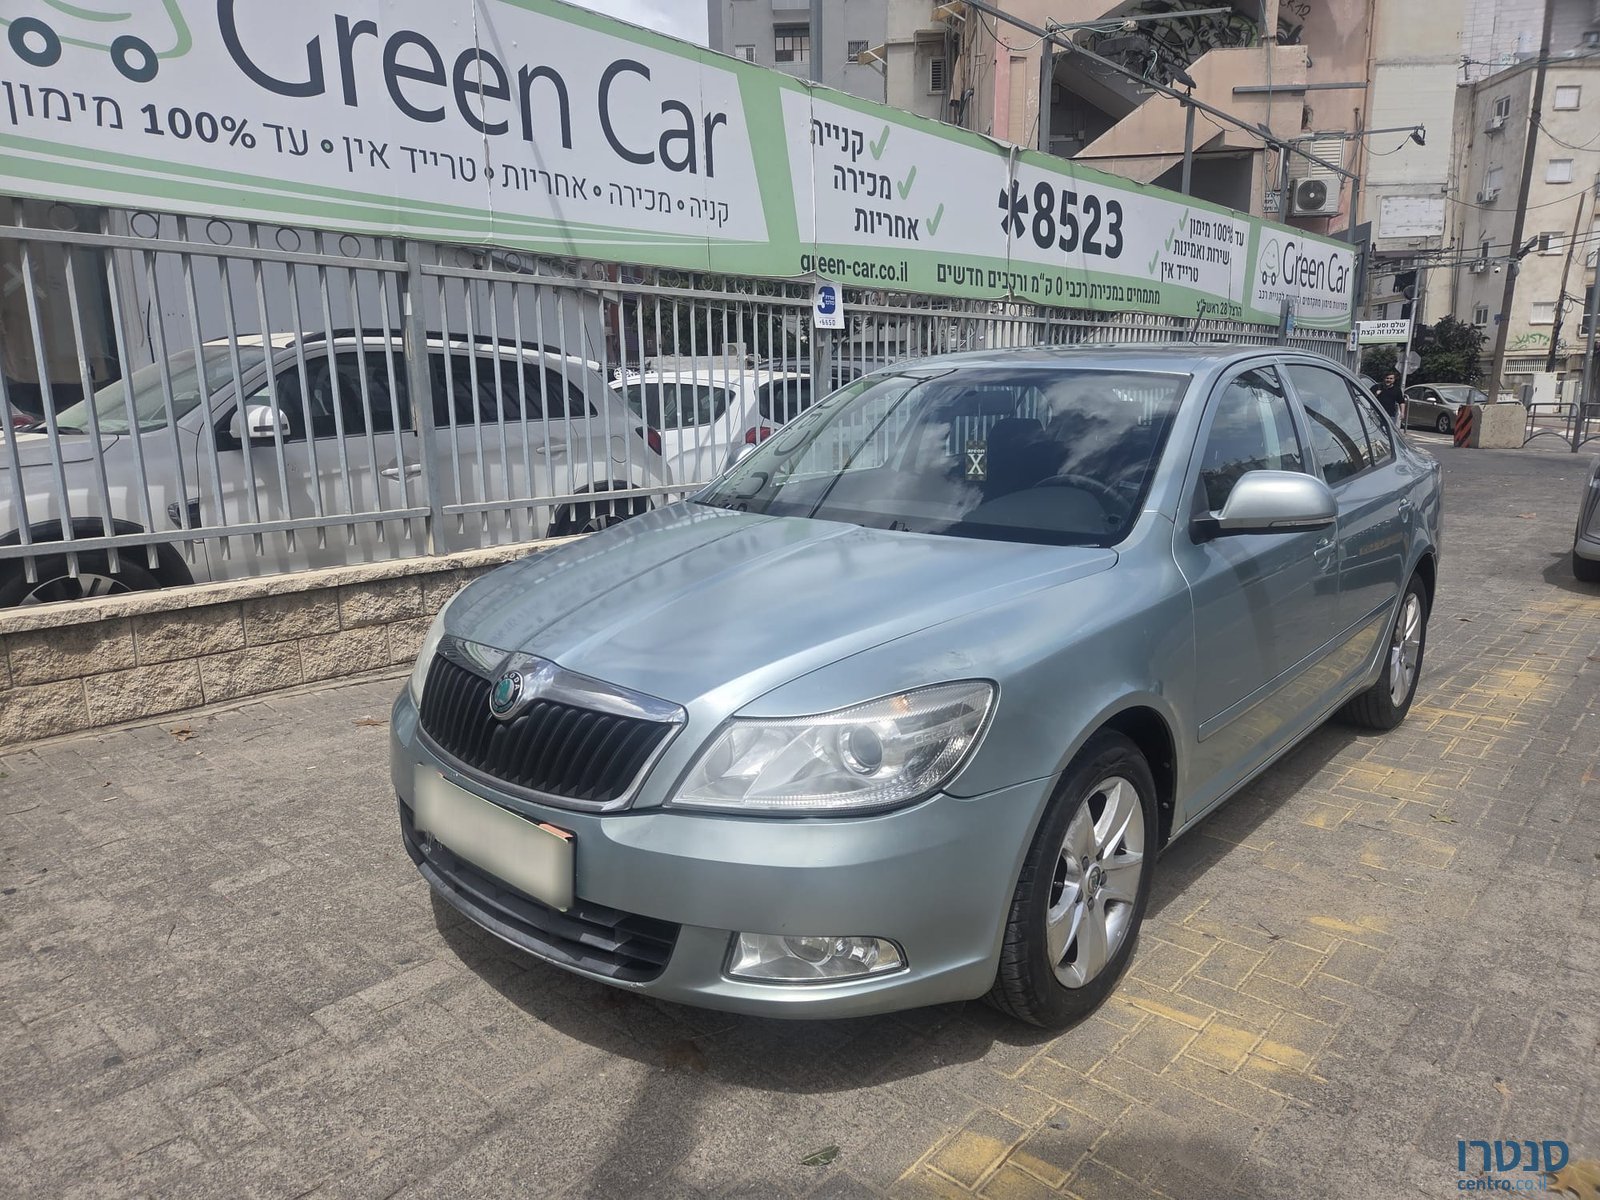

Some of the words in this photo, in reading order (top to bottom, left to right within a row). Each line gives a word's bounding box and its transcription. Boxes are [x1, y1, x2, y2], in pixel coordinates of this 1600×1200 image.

[217, 0, 572, 150] Green
[598, 58, 727, 178] Car
[1, 80, 123, 130] מימון
[140, 103, 257, 149] 100%
[262, 122, 309, 156] עד
[811, 118, 864, 163] קנייה
[342, 136, 391, 172] אין
[399, 145, 476, 182] טרייד
[501, 164, 587, 200] אחריות
[833, 164, 892, 200] מכירה
[609, 182, 671, 213] מכירה
[690, 197, 729, 228] קניה
[854, 206, 920, 241] אחריות
[1189, 218, 1211, 239] מימון
[1212, 221, 1233, 244] 100%
[1234, 230, 1245, 247] עד
[1173, 238, 1205, 261] ואמינות
[1206, 246, 1230, 265] שירות
[800, 252, 908, 283] green-car.co.il
[937, 263, 984, 287] חדשים
[1160, 261, 1175, 283] אין
[1176, 264, 1199, 283] טרייד
[1282, 241, 1325, 290] Green
[1327, 252, 1350, 294] Car
[988, 270, 1027, 292] ורכבים
[1055, 276, 1063, 296] 0
[1065, 280, 1088, 299] רכבי
[1089, 282, 1124, 302] במכירת
[1126, 286, 1160, 305] מתמחים
[1390, 321, 1406, 329] שלם
[967, 453, 985, 475] X
